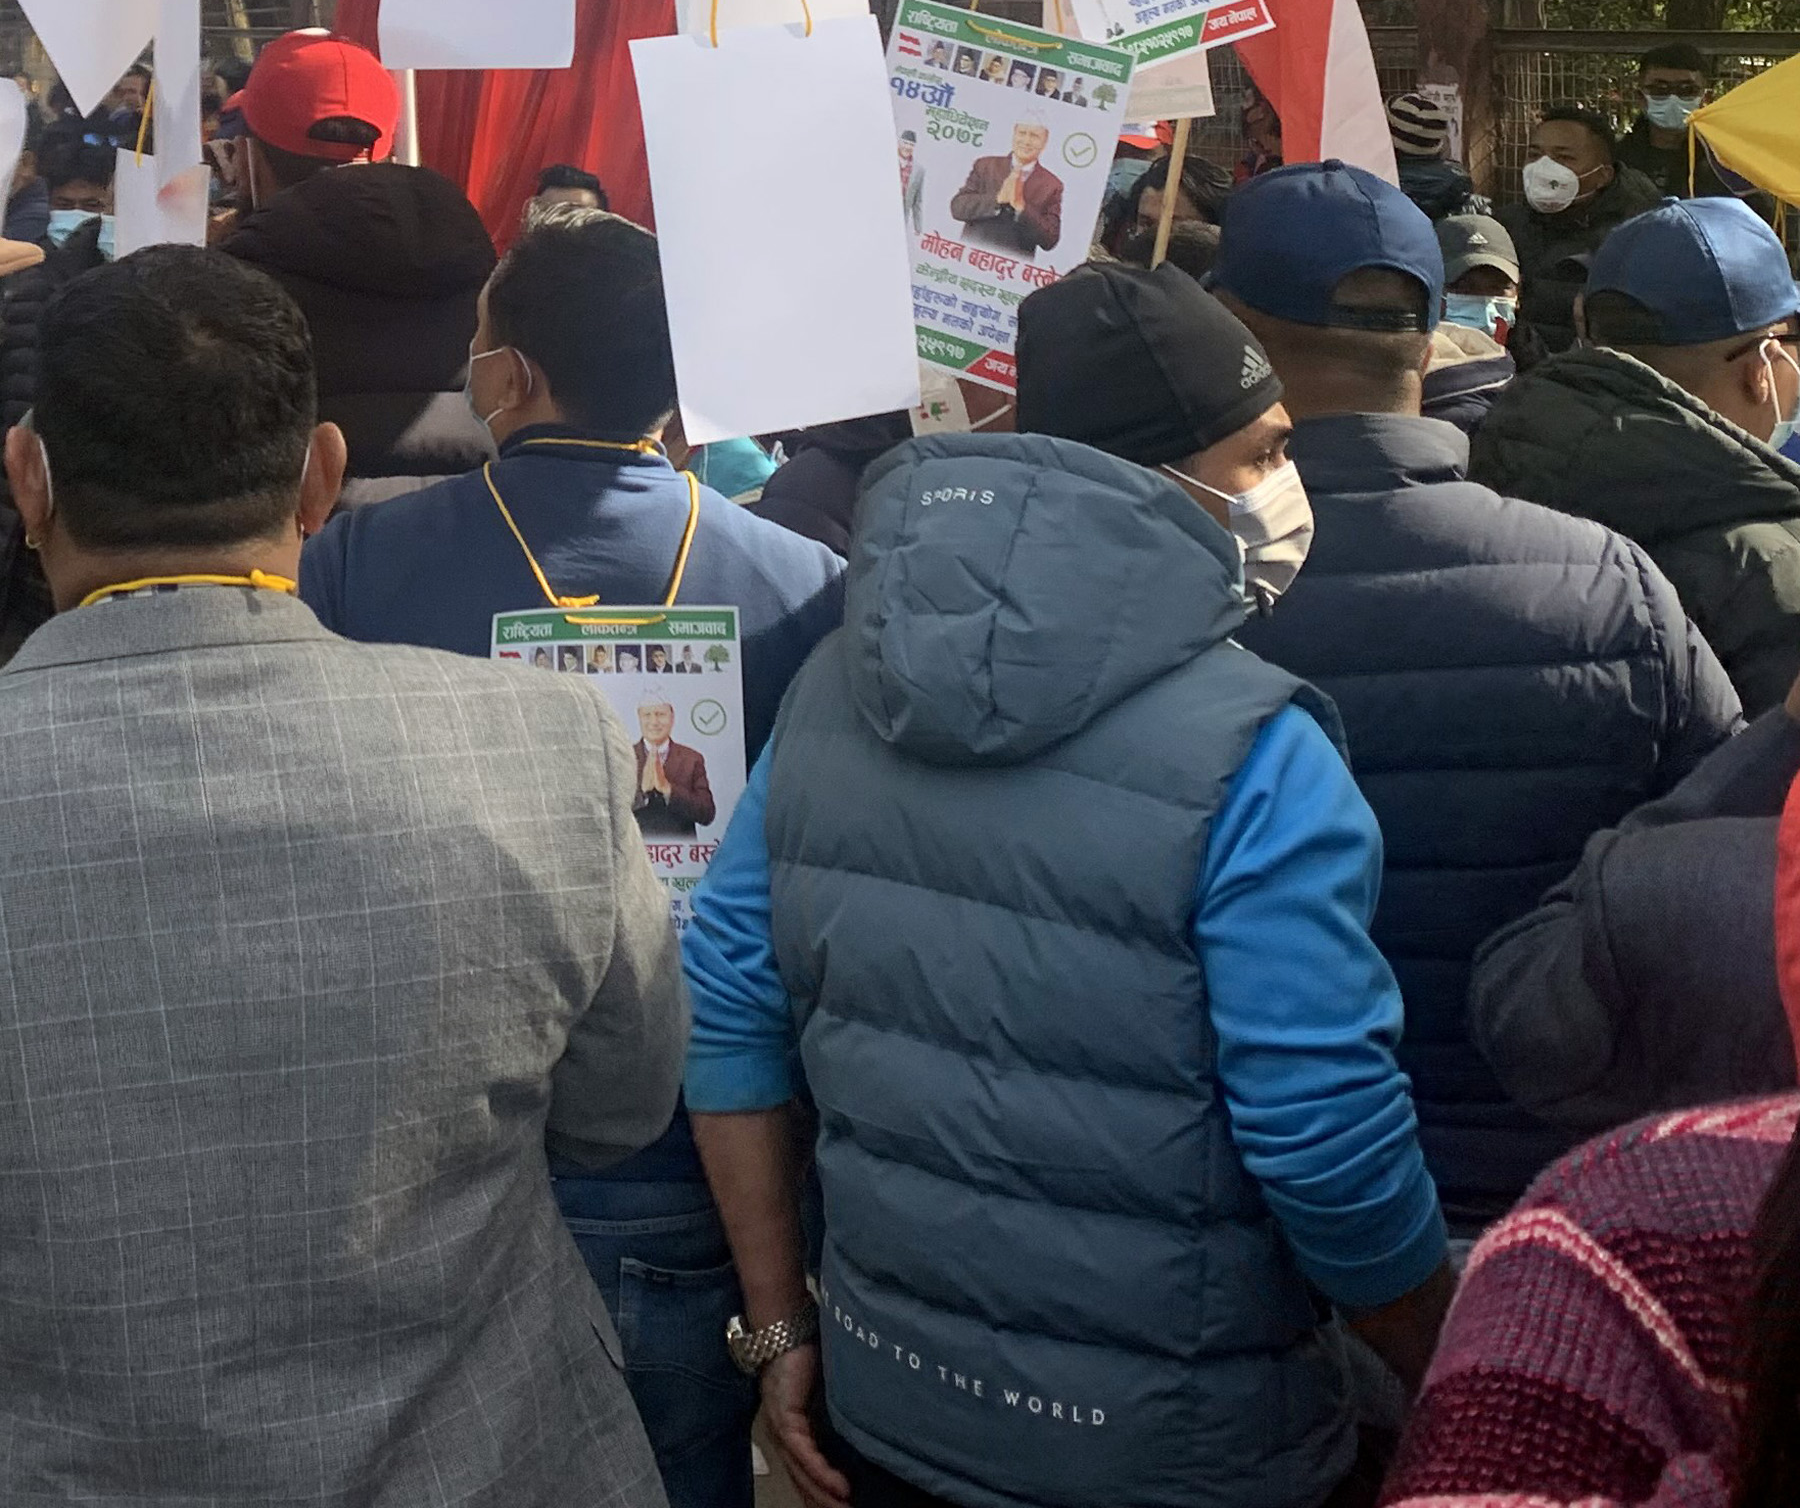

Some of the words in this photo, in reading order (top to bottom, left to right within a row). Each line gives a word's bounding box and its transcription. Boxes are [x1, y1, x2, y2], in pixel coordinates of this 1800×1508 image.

[1208, 17, 1228, 30] जय
[1228, 7, 1258, 25] नेपाल
[907, 9, 958, 33] राष्ट्रियता
[1067, 51, 1124, 77] समाजवाद
[926, 120, 984, 148] २०७८
[921, 230, 966, 262] मोहन
[968, 248, 1019, 280] बहादुर
[1022, 264, 1064, 287] बस्ने
[918, 334, 966, 360] २५९१७
[502, 621, 553, 641] राष्ट्रियता
[667, 618, 727, 636] समाजवाद
[644, 844, 683, 868] हादुर
[893, 1344, 920, 1369] TO
[938, 1365, 984, 1397] THE
[1003, 1389, 1106, 1426] WORLD
